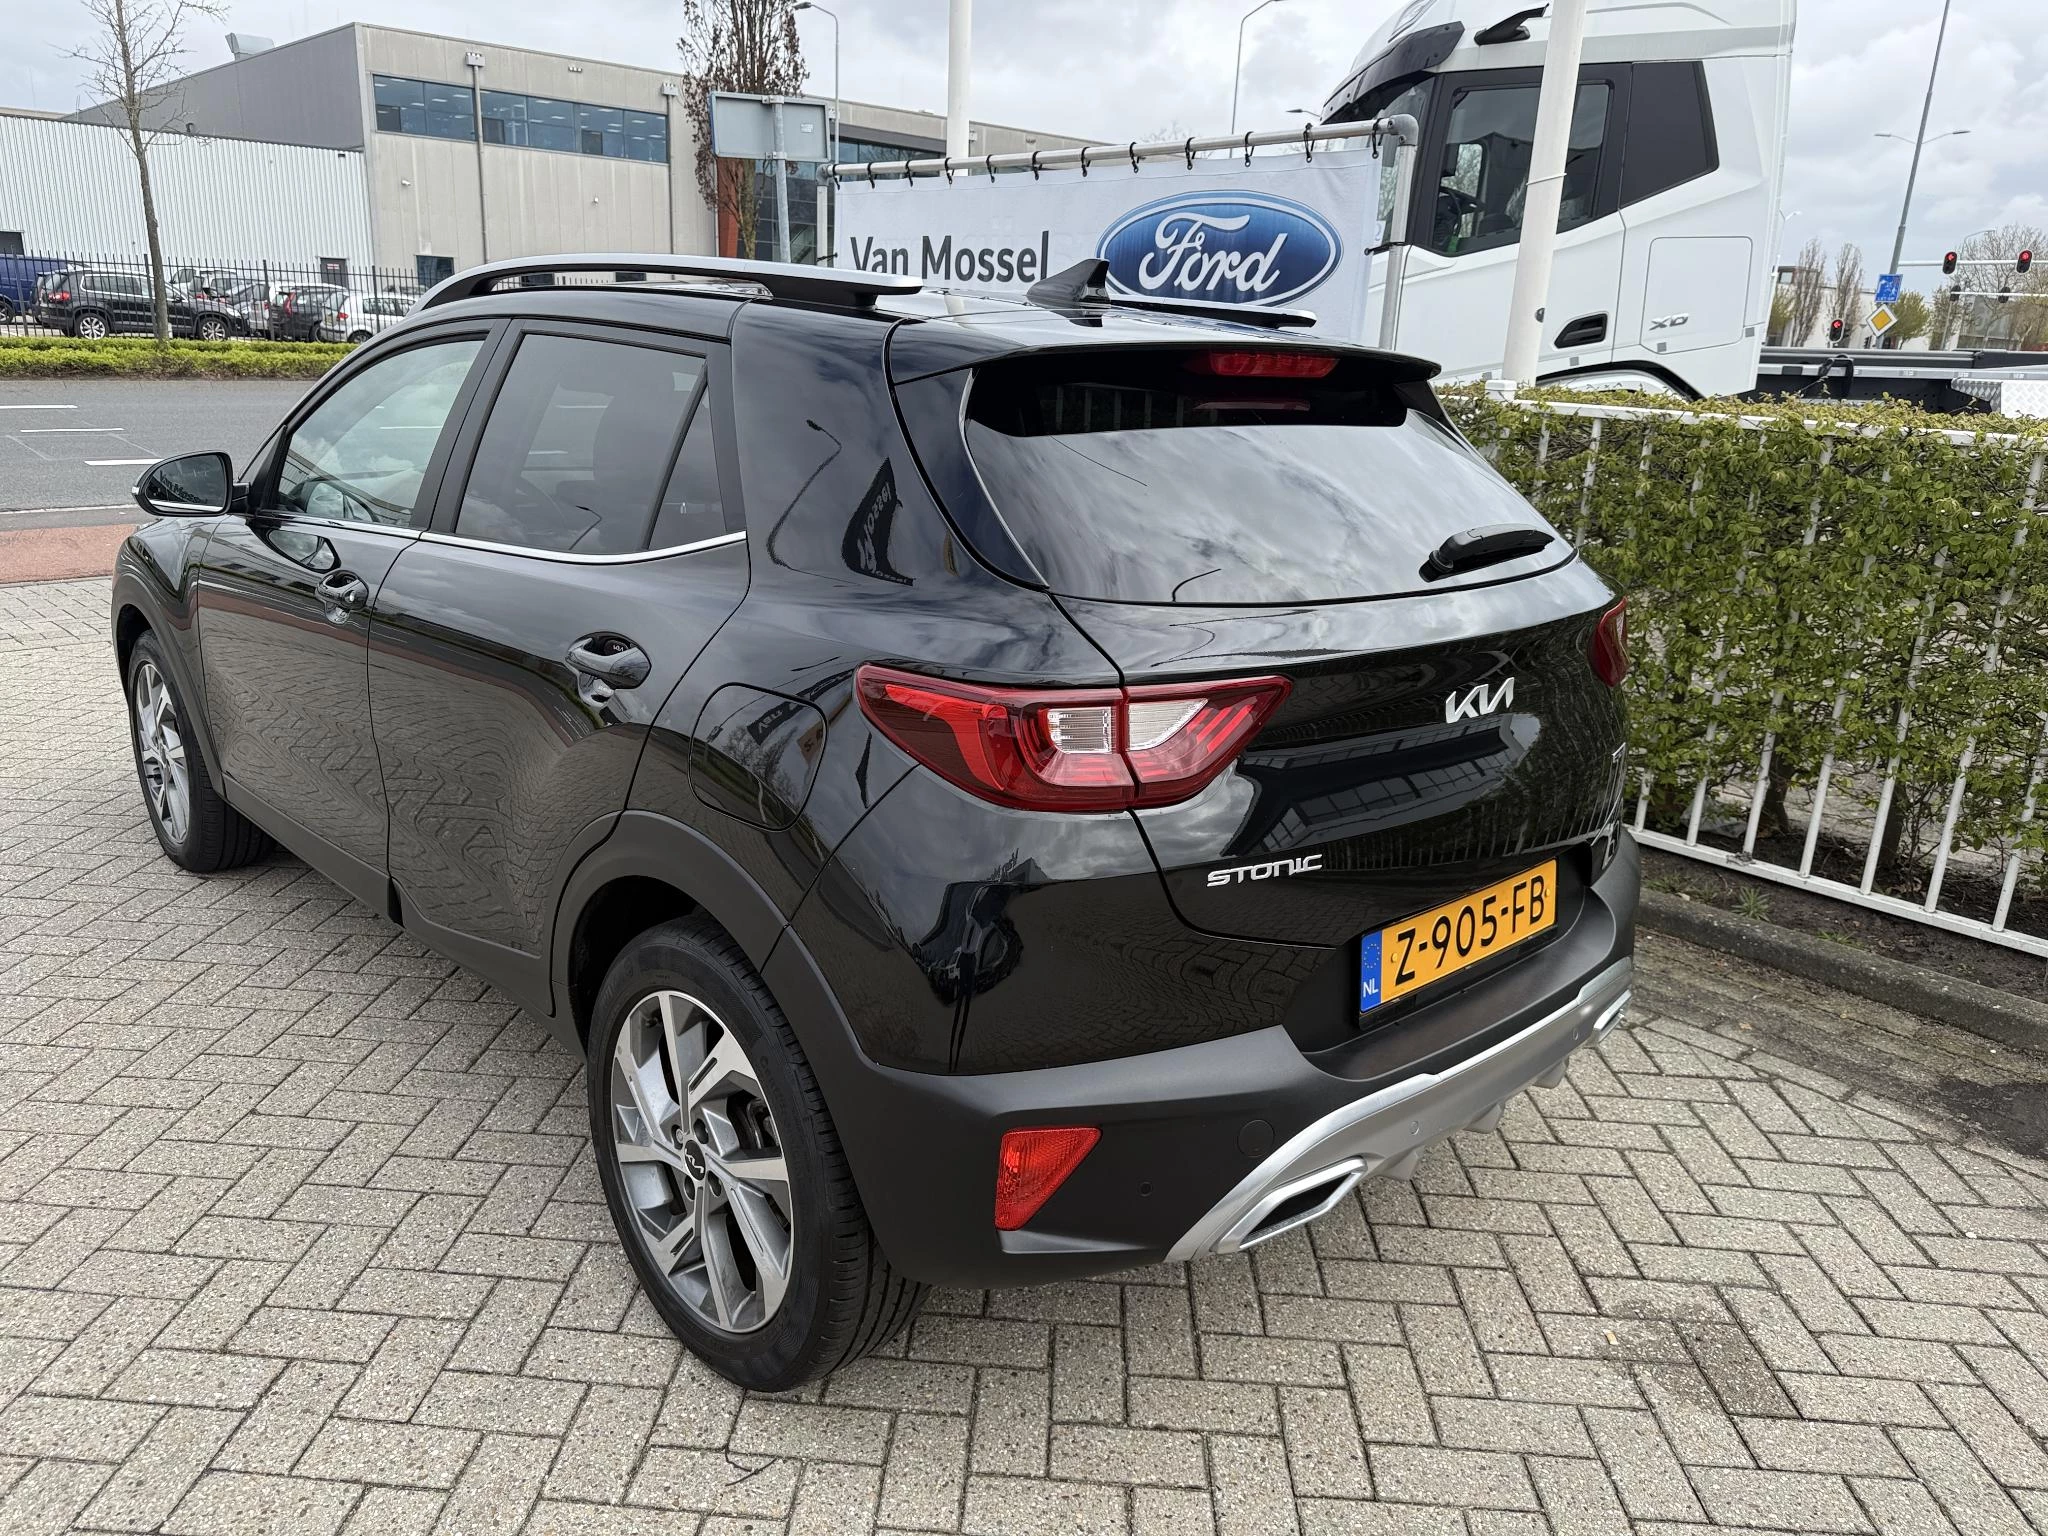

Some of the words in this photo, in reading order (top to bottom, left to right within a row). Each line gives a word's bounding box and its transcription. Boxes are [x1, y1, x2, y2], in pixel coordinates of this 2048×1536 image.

[850, 236, 909, 276] Van
[922, 230, 1049, 283] Mossel
[1138, 211, 1288, 293] Ford
[1445, 677, 1514, 724] KIA
[1207, 854, 1322, 888] STONIC
[1394, 875, 1545, 987] Z-905-FB
[1363, 977, 1379, 998] NL
